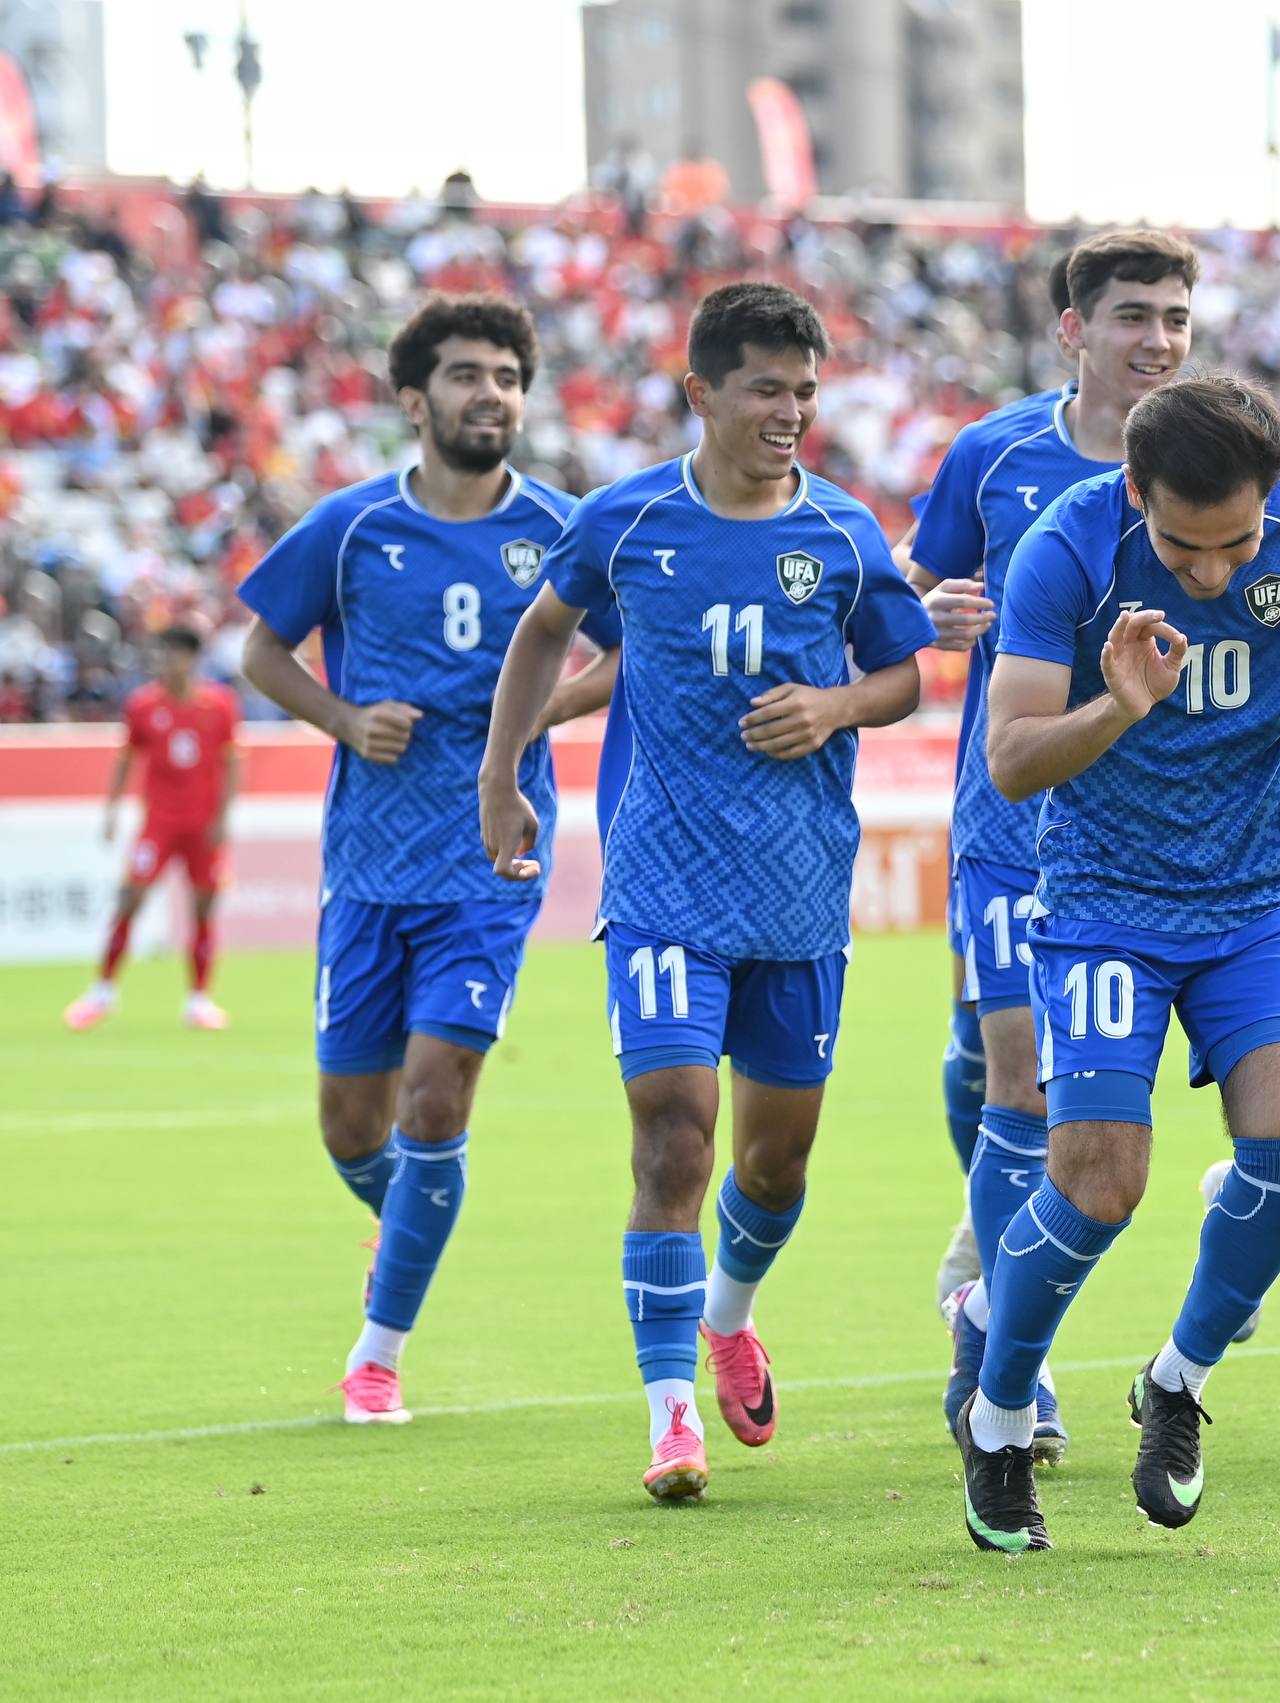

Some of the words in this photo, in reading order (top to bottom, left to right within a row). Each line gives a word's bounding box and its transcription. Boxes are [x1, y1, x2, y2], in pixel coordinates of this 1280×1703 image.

[783, 559, 815, 582] UFA
[443, 582, 481, 652] 8
[702, 604, 763, 676] 11
[1180, 640, 1251, 715] 10
[628, 944, 689, 1020] 11
[1063, 960, 1134, 1040] 10
